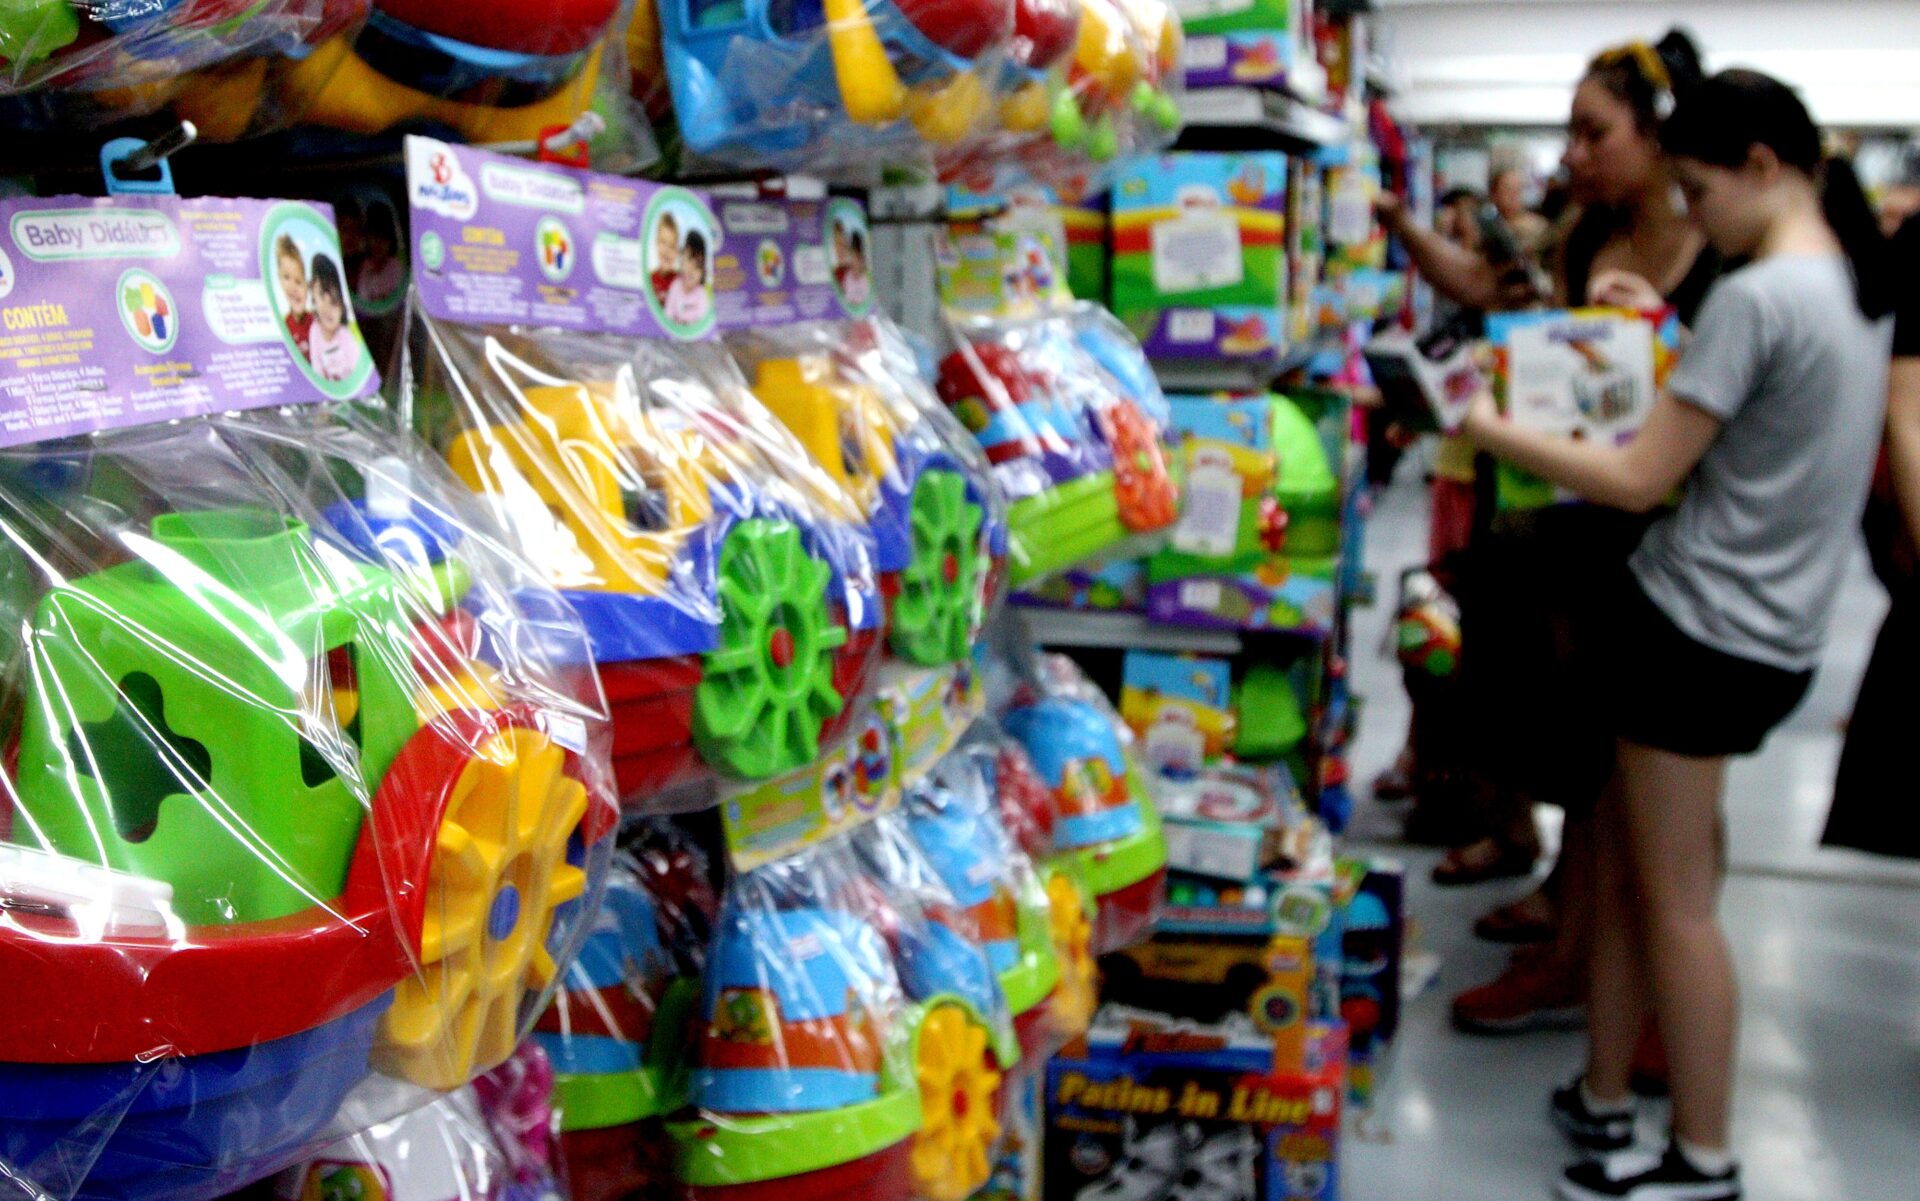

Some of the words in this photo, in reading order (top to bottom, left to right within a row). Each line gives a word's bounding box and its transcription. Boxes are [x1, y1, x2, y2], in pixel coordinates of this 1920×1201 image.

[25, 223, 83, 249] Baby
[3, 299, 69, 330] CONTÉM
[1058, 1073, 1171, 1114] Patins
[1228, 1087, 1311, 1125] Line
